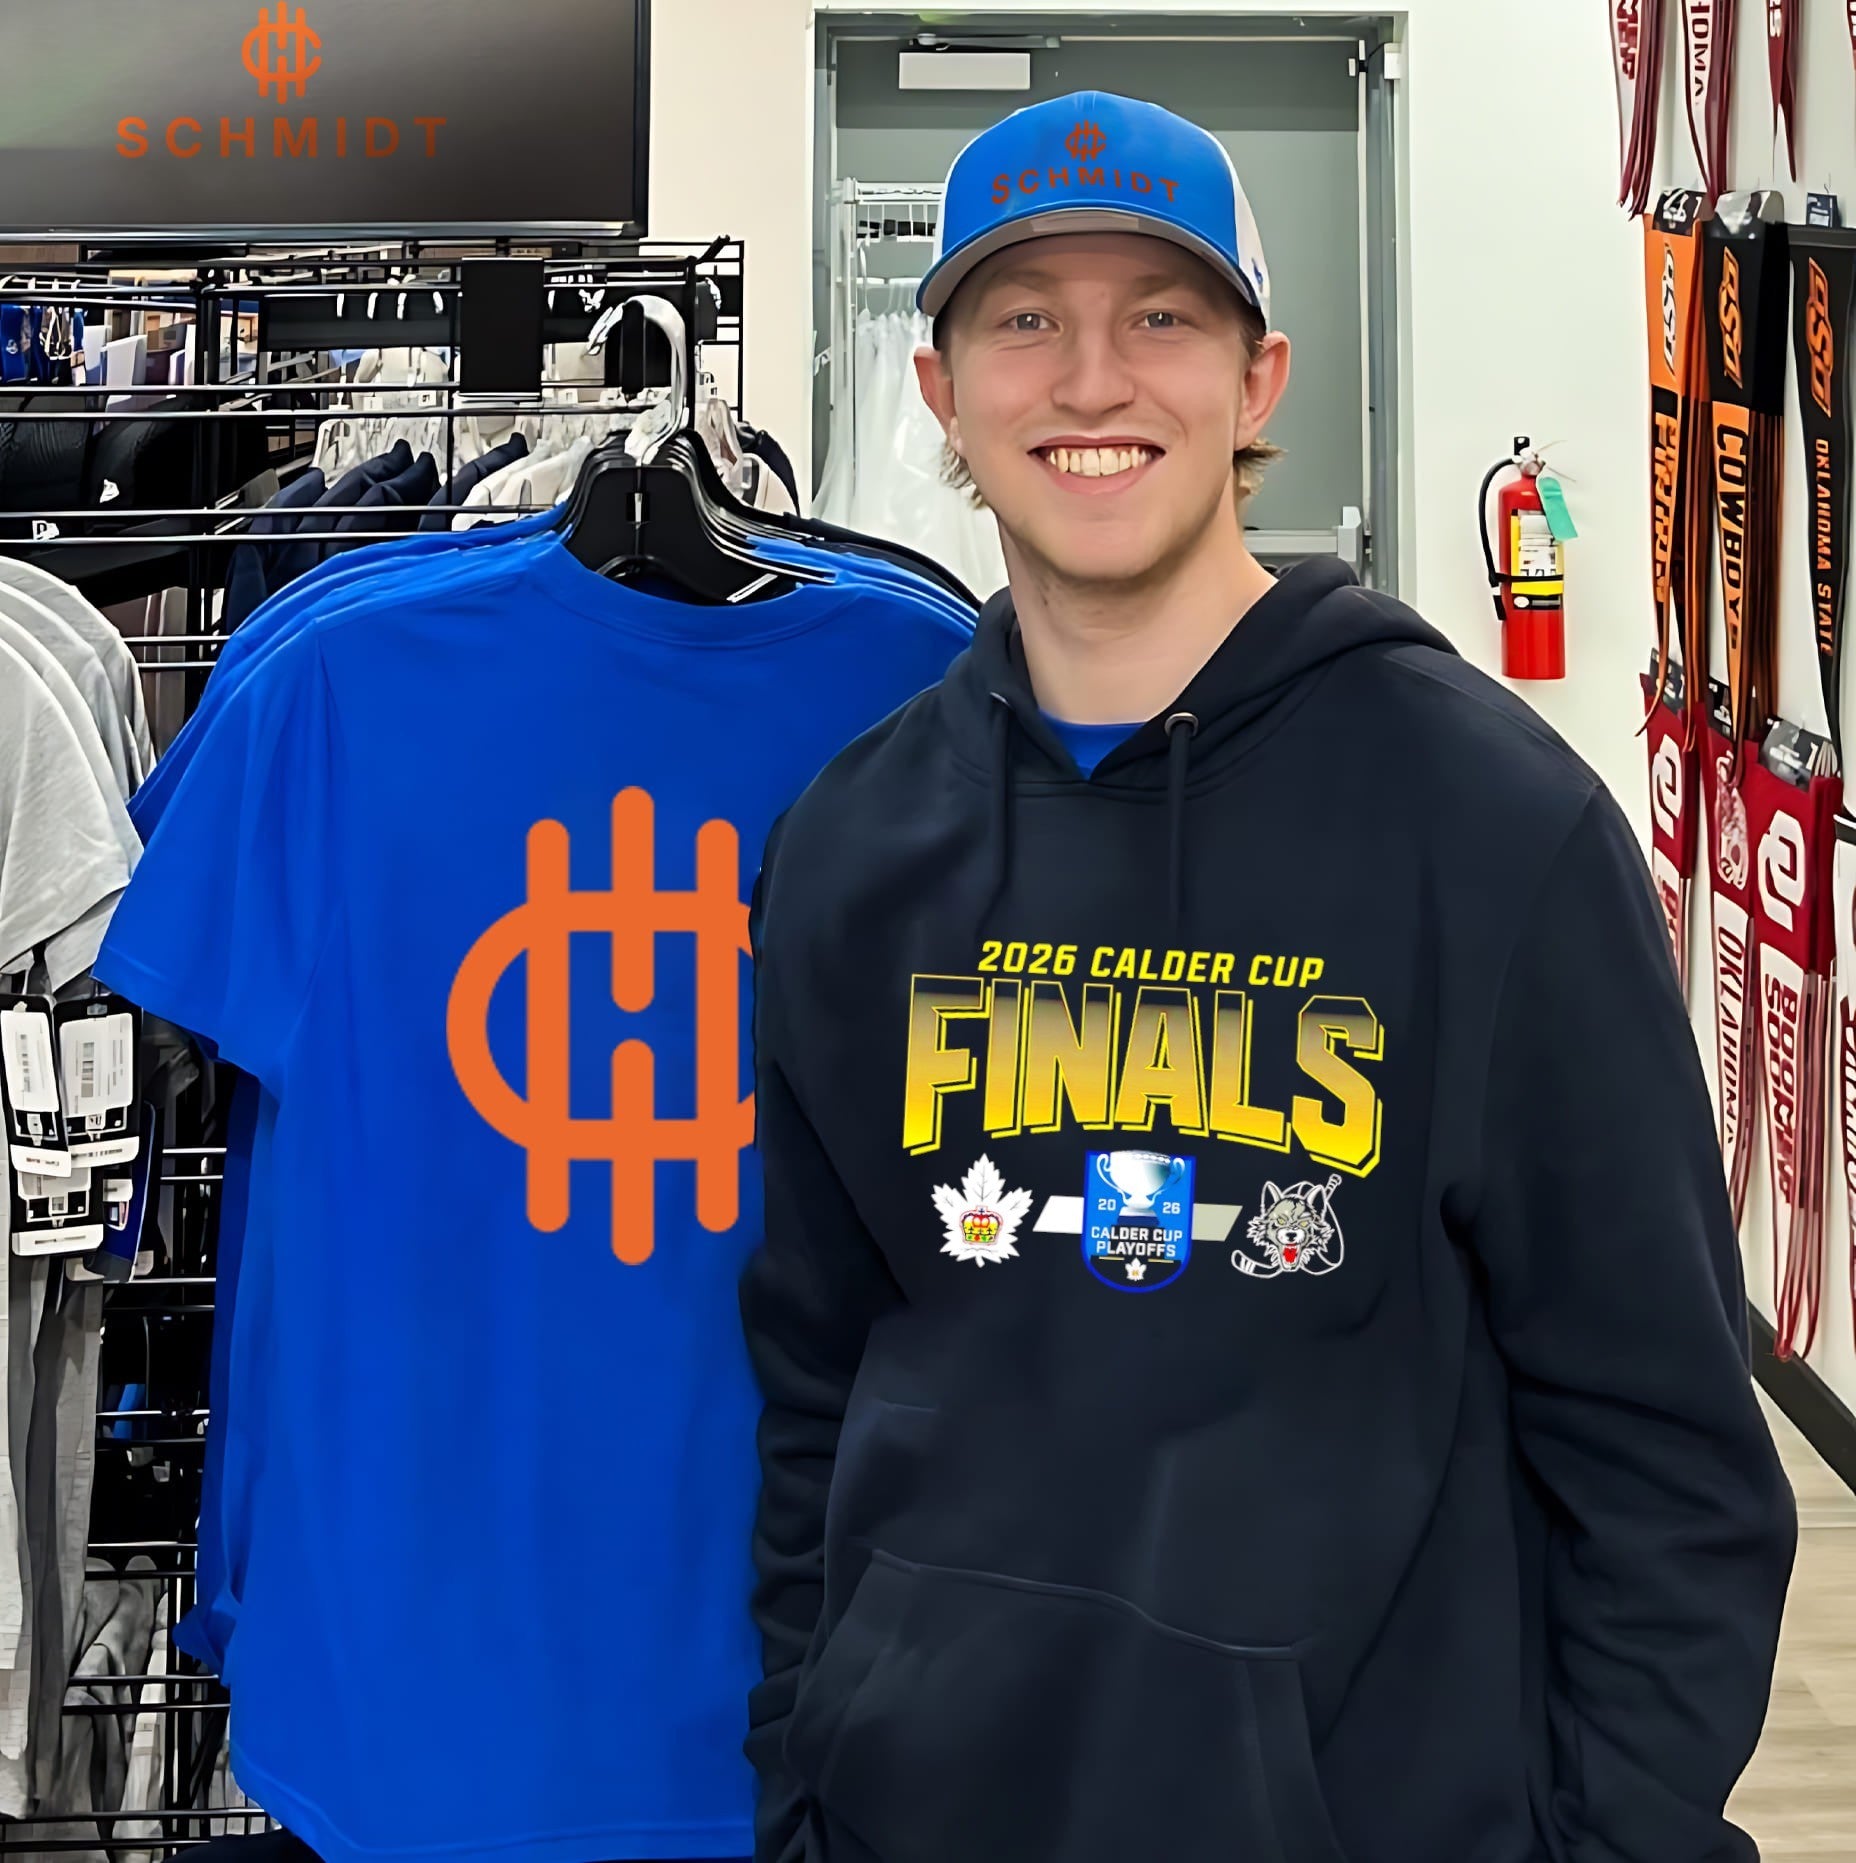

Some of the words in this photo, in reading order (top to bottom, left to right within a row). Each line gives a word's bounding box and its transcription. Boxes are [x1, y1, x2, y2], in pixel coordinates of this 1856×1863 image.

[116, 117, 447, 158] SCHMIDT
[991, 167, 1180, 205] SCHMIDT
[1815, 438, 1832, 570] OKLAHOMA
[978, 940, 1078, 976] 2026
[1090, 946, 1235, 984] CALDER
[1248, 954, 1325, 988] CUP
[902, 973, 1385, 1178] FINALS
[1098, 1199, 1116, 1211] 20
[1162, 1202, 1180, 1214] 26
[1091, 1226, 1149, 1241] CALDER
[1153, 1228, 1182, 1242] CUP
[1096, 1241, 1176, 1257] PLAYOFFS
